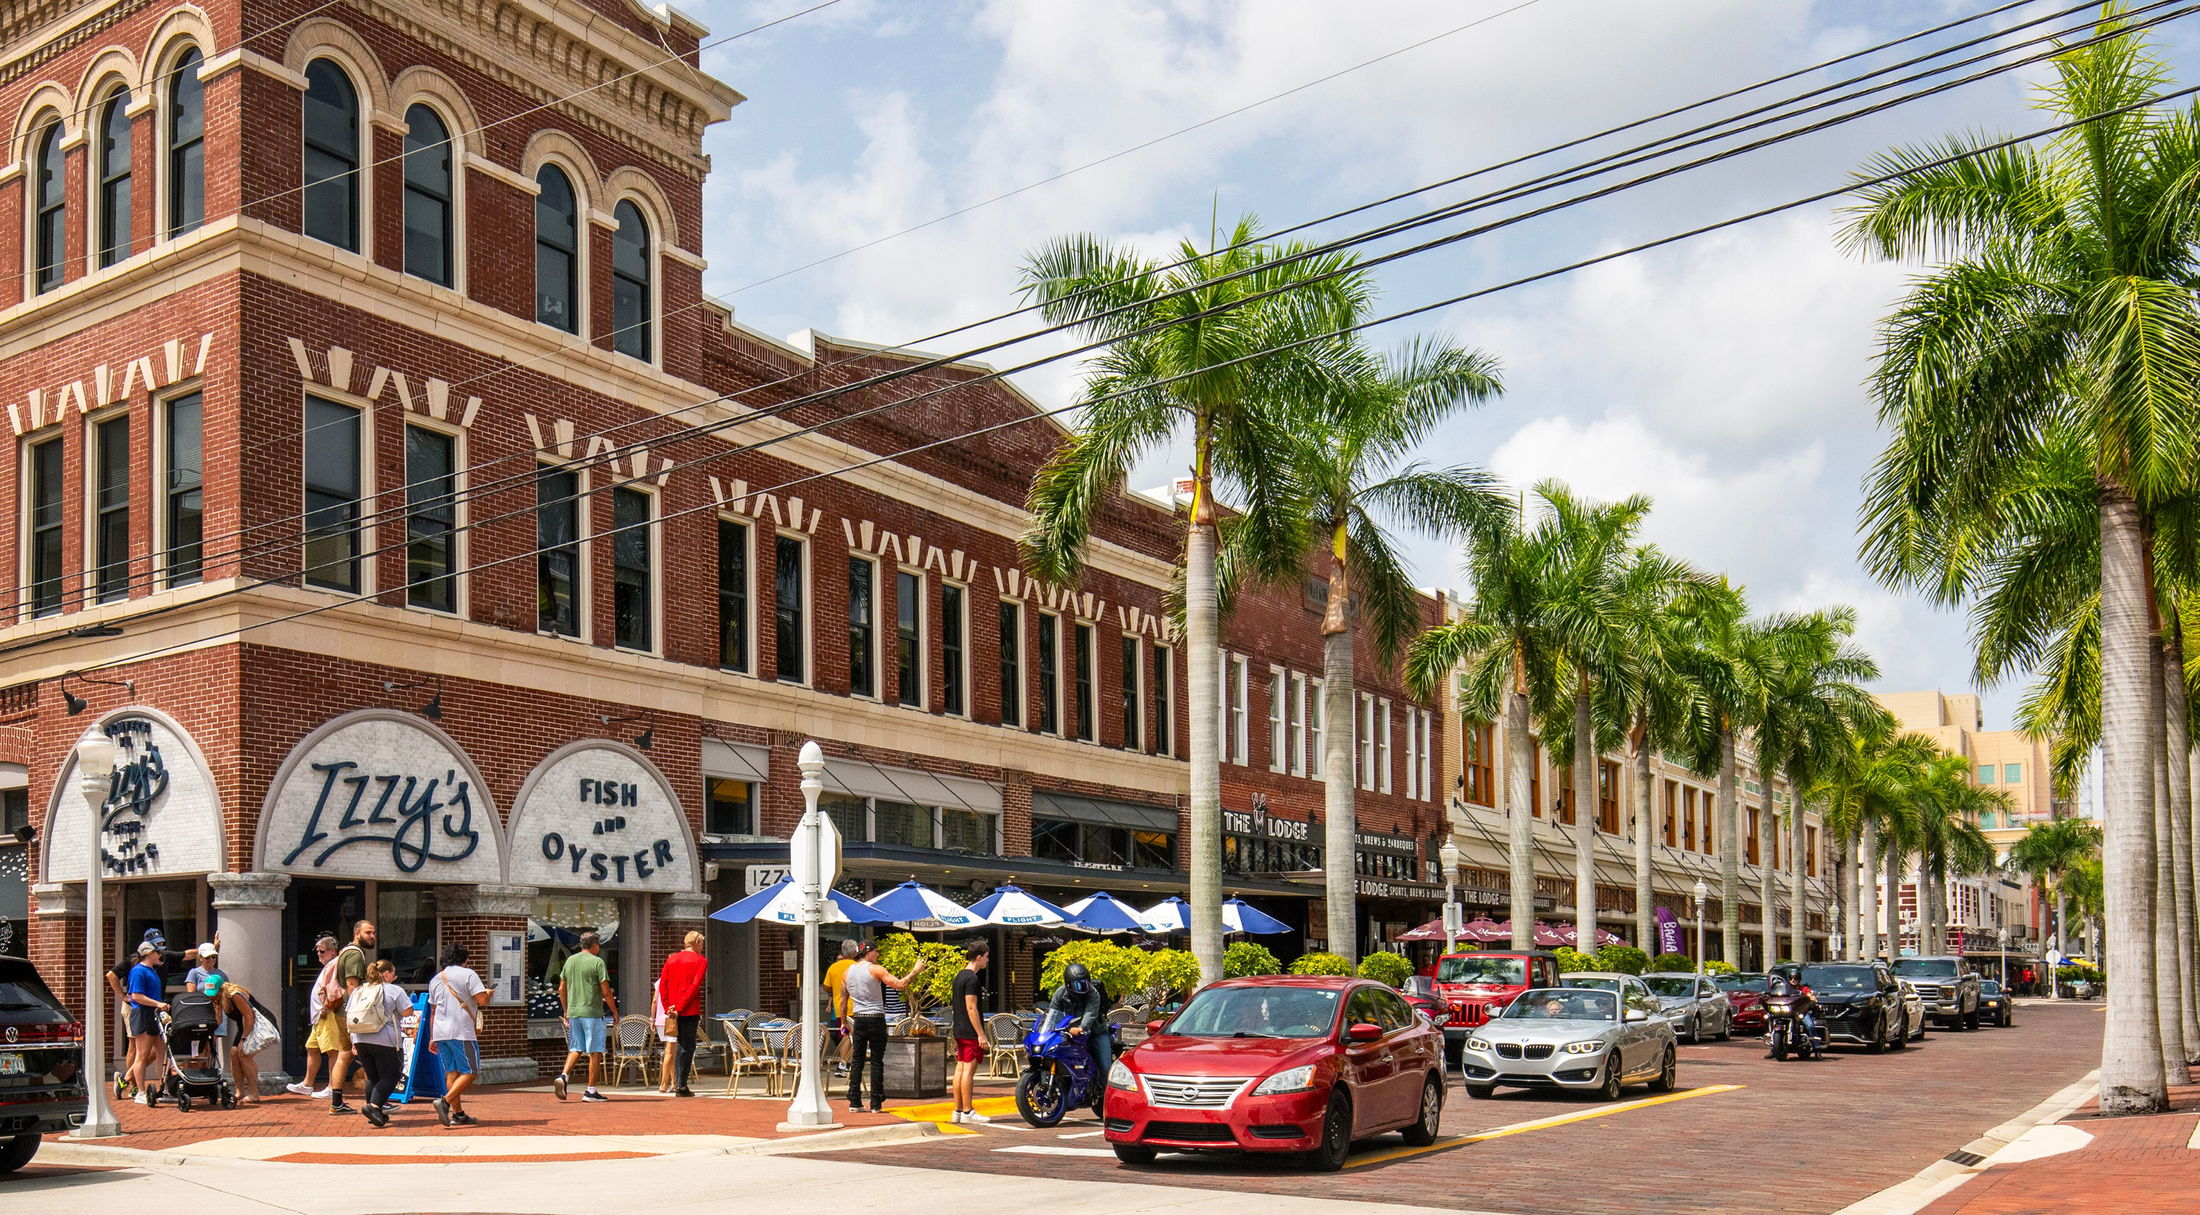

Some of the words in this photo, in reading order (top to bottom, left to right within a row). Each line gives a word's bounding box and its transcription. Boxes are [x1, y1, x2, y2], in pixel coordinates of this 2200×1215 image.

[580, 778, 638, 808] FISH
[282, 761, 479, 874] Izzy's
[592, 816, 626, 836] AND
[1223, 811, 1251, 834] THE
[1267, 818, 1308, 841] LODGE
[1364, 834, 1381, 847] BREWS
[541, 832, 674, 883] OYSTER
[1360, 880, 1388, 897] LODGE
[1389, 886, 1408, 899] SPORTS,
[1409, 887, 1426, 898] BREWS
[1464, 890, 1477, 903] THE
[1478, 891, 1499, 905] LODGE
